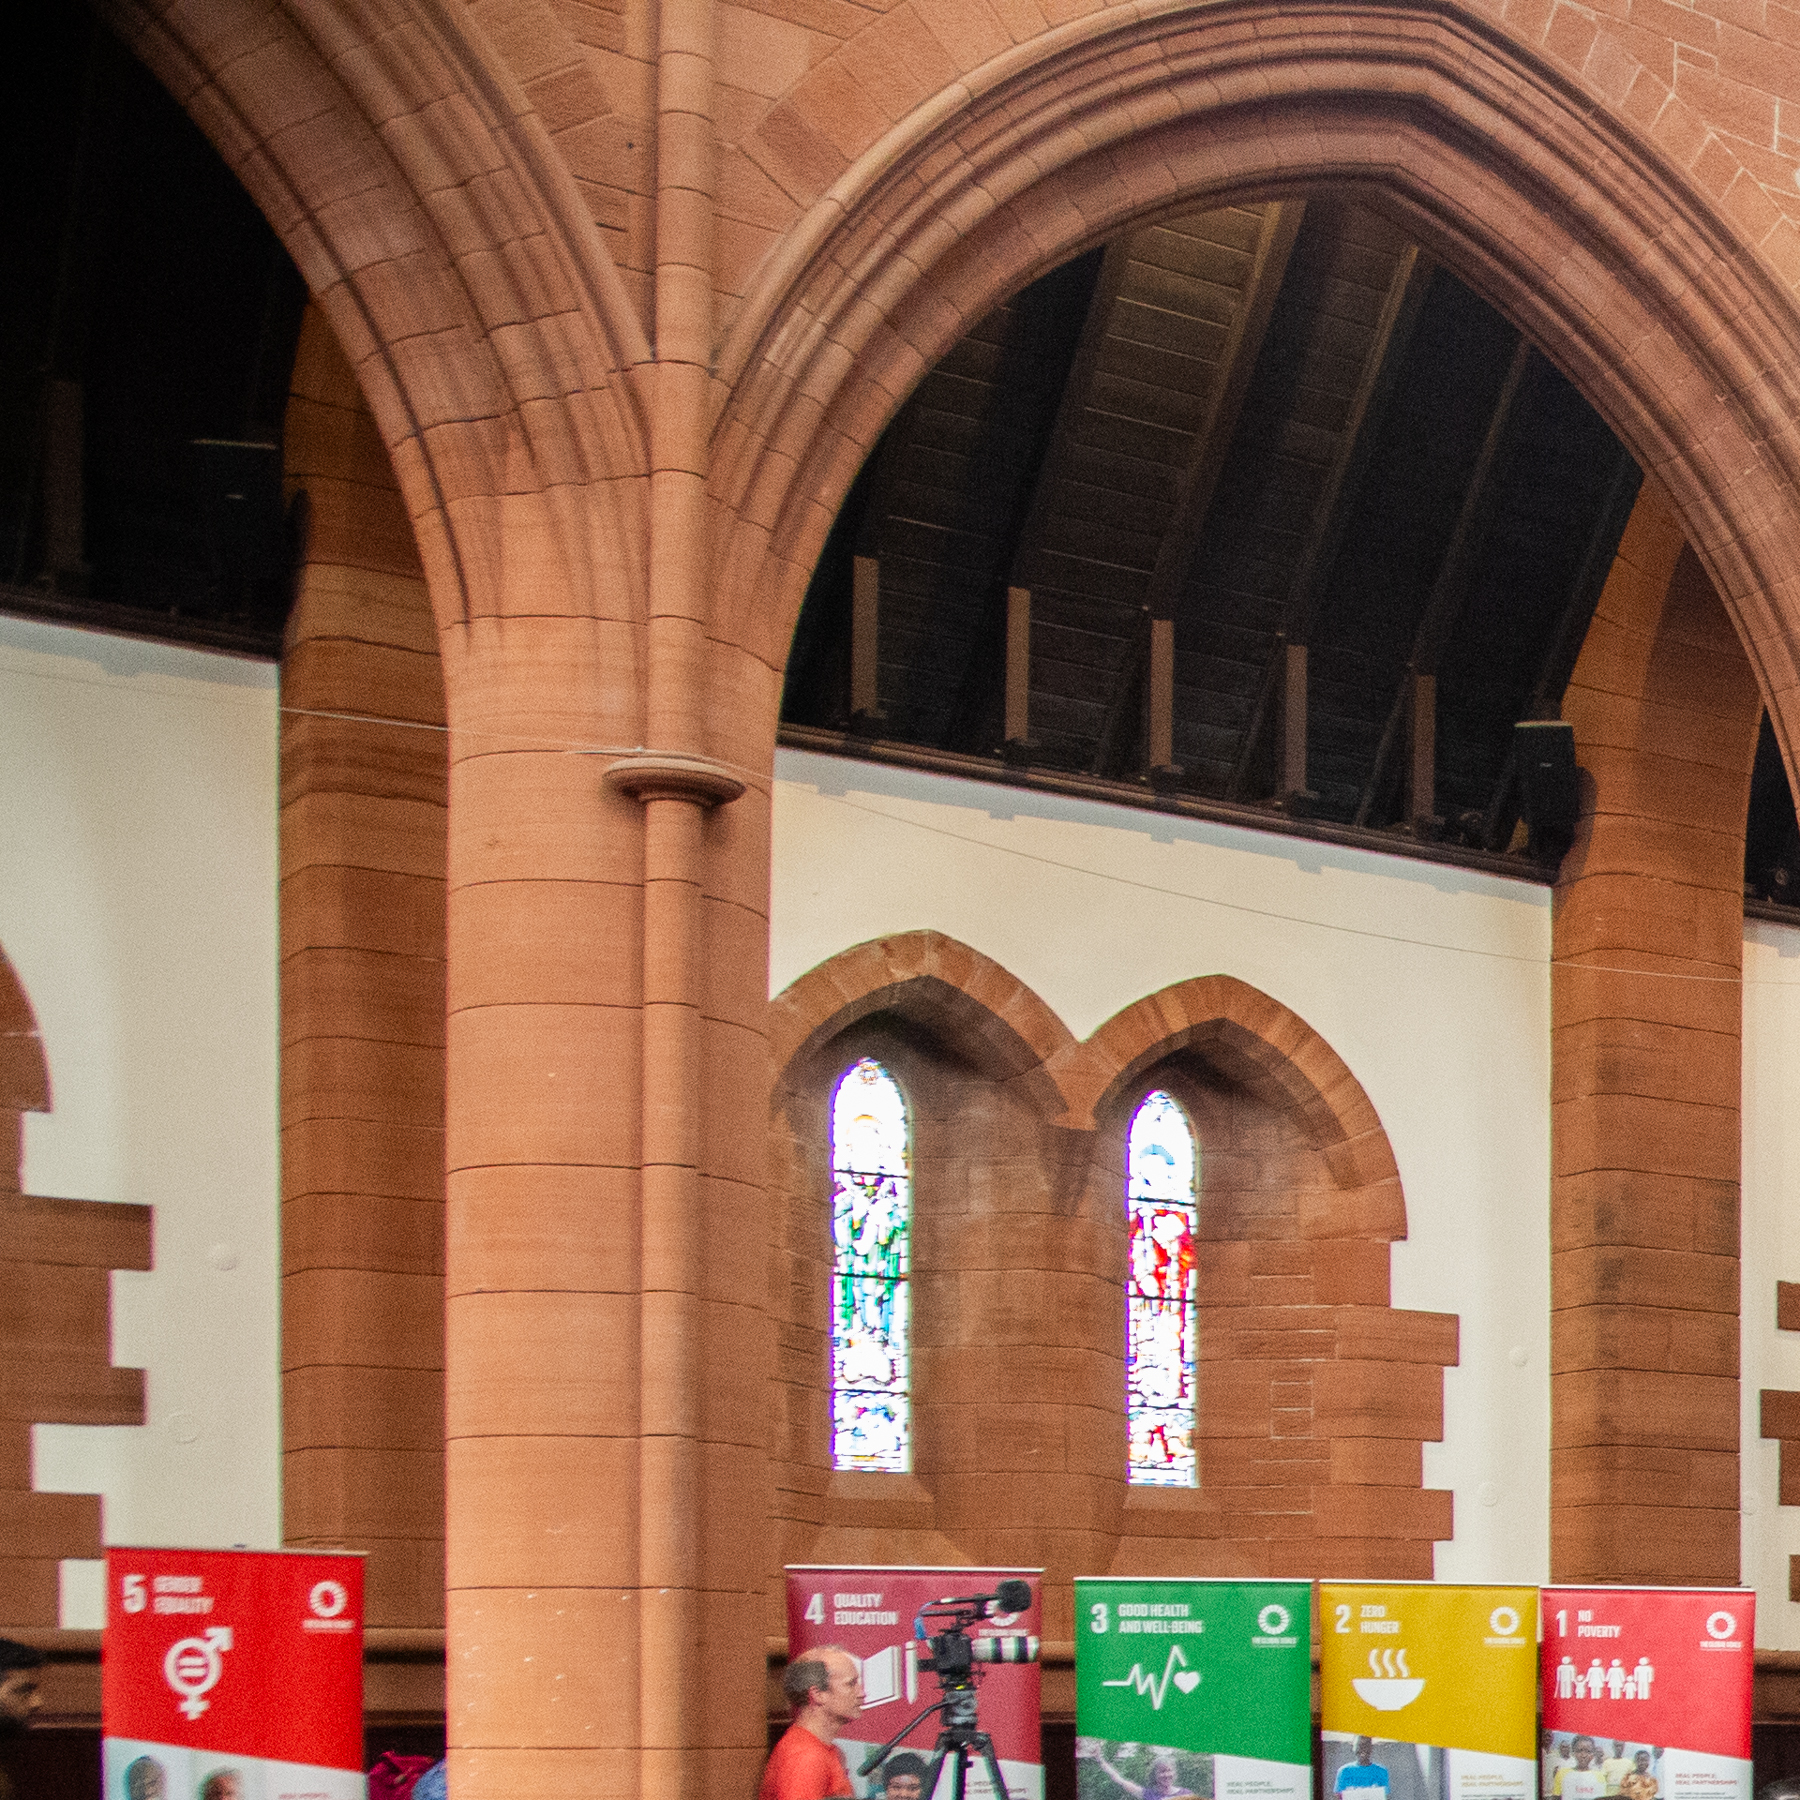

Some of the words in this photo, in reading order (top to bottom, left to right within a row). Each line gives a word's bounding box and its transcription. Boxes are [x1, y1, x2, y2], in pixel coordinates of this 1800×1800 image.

[122, 1573, 147, 1614] 5
[834, 1593, 882, 1608] QUALITY
[804, 1593, 826, 1625] 4
[1118, 1604, 1147, 1617] GOOD
[1149, 1604, 1189, 1617] HEALTH
[1360, 1604, 1386, 1618] ZERO
[1578, 1609, 1592, 1622] NO
[834, 1611, 899, 1625] EDUCATION
[1091, 1603, 1108, 1634] 3
[1335, 1604, 1351, 1634] 2
[1556, 1609, 1568, 1637] 1
[1118, 1621, 1141, 1634] AND
[1142, 1621, 1203, 1634] WELL-BEING
[1360, 1621, 1400, 1634] HUNGER
[1578, 1625, 1622, 1638] POVERTY
